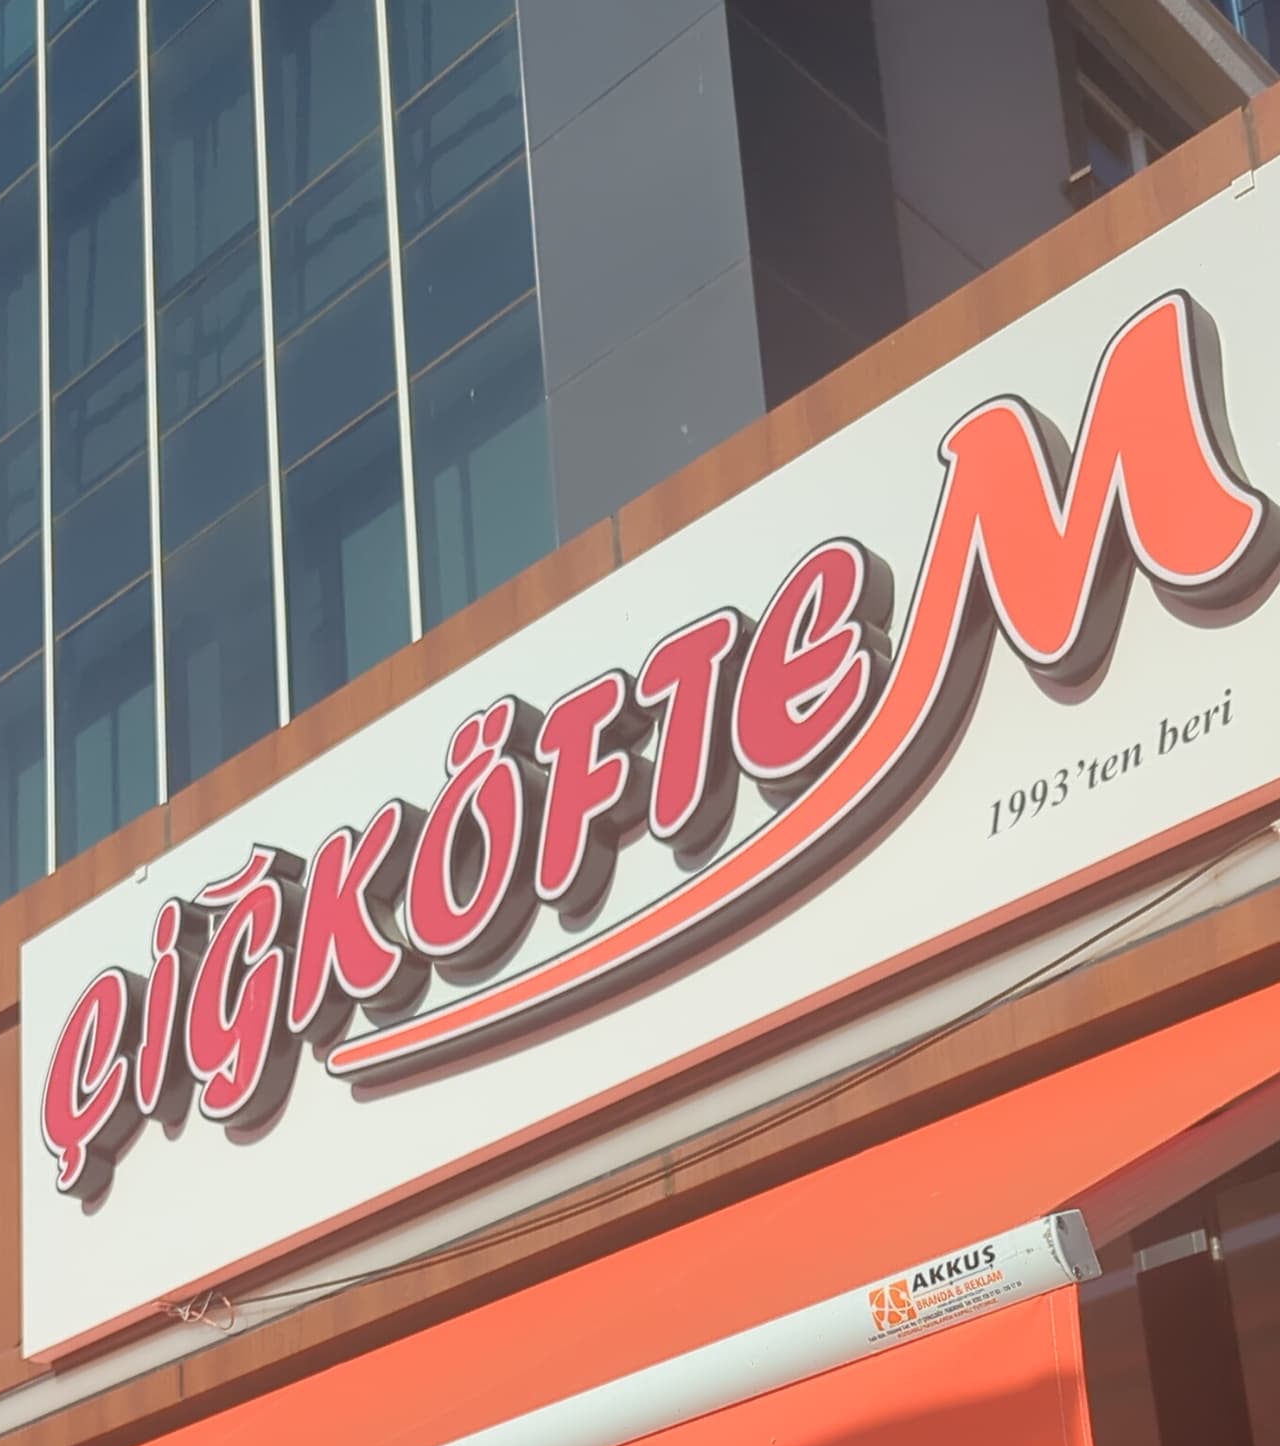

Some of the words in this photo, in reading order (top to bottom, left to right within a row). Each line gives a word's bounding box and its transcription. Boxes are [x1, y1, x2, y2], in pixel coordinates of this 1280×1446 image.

[1157, 687, 1234, 756] beri
[912, 1244, 997, 1293] AKKUŞ
[916, 1287, 954, 1311] BRANDA
[965, 1269, 1004, 1291] REKLAM
